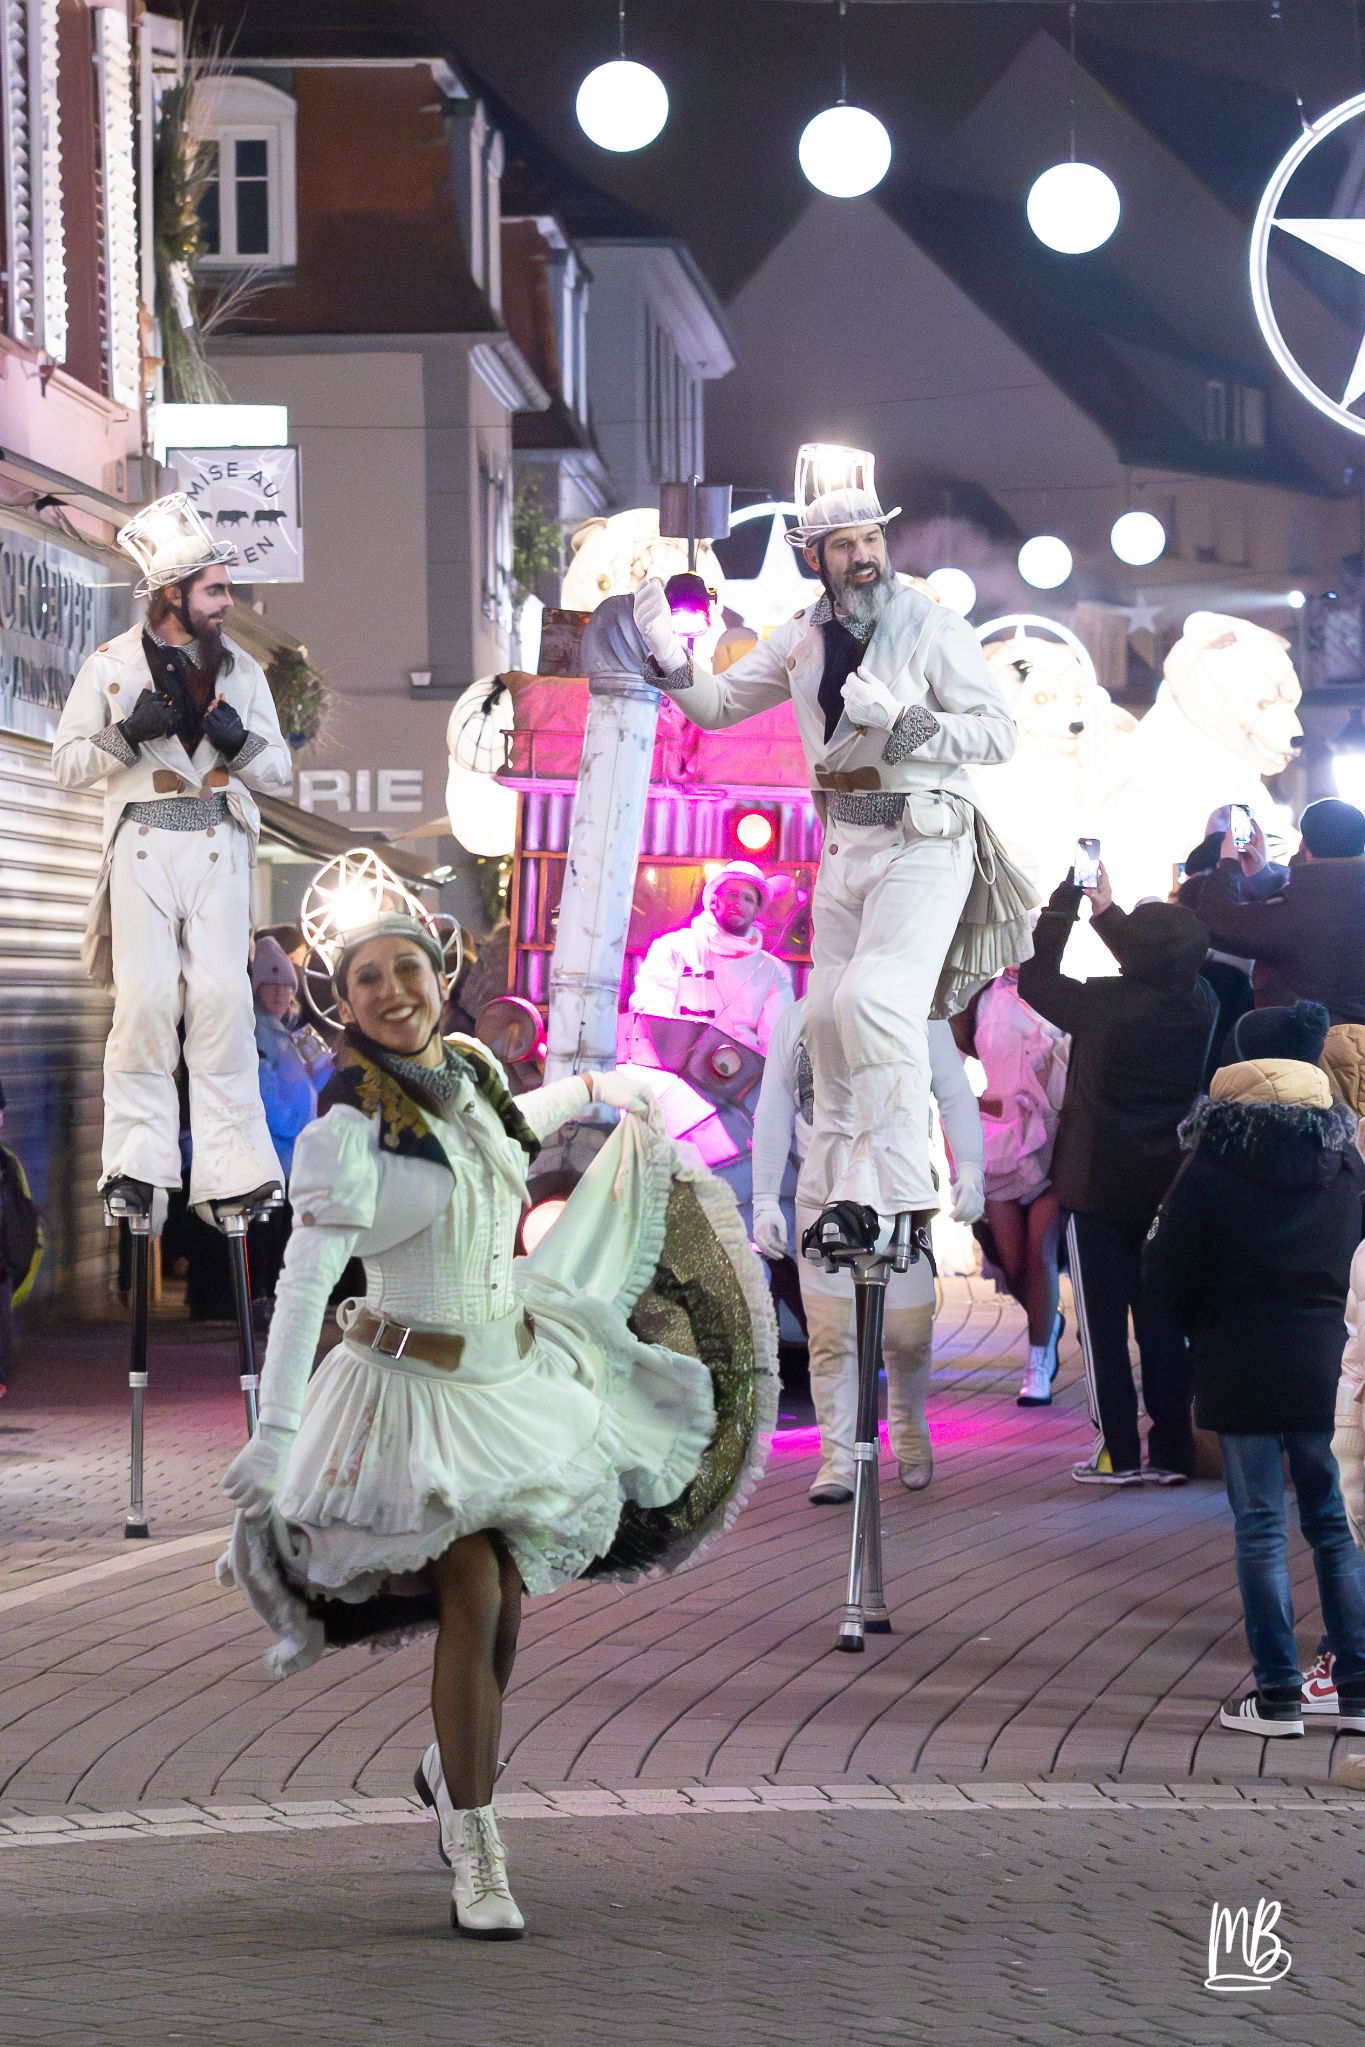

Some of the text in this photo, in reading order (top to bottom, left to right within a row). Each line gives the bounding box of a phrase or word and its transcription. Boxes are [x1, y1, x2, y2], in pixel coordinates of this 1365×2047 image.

[186, 462, 280, 502] MISE AU
[226, 536, 275, 567] EEN
[284, 769, 423, 812] RIE
